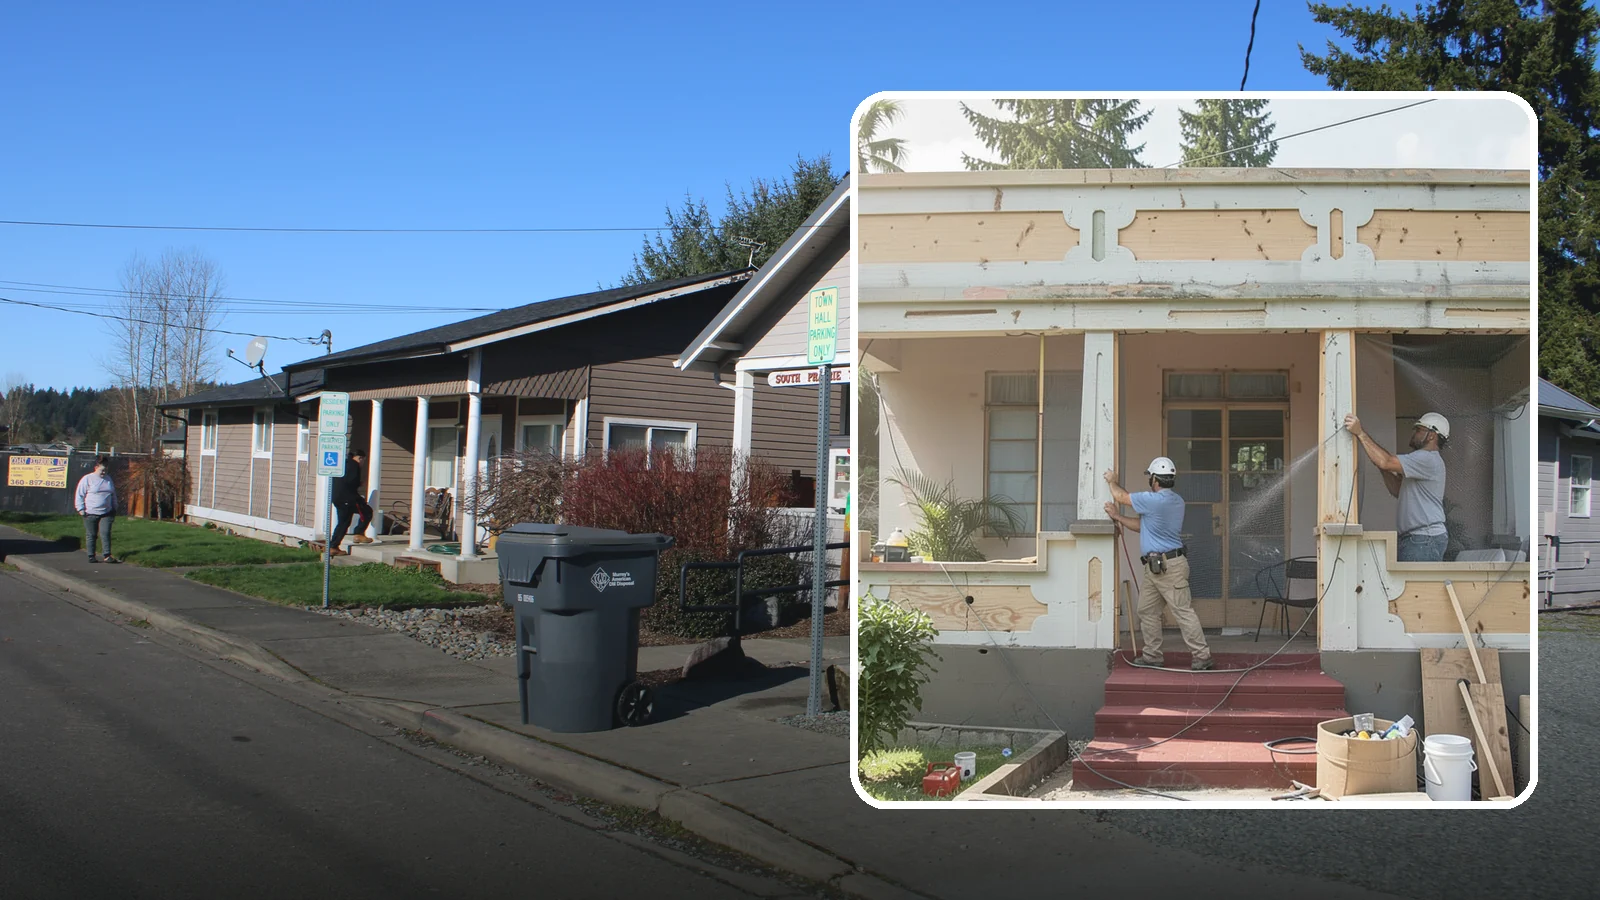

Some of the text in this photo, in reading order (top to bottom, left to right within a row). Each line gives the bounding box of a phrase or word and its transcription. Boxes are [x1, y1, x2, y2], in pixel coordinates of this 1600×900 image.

[815, 294, 833, 308] TOWN
[814, 312, 831, 325] HALL
[810, 326, 836, 341] PARKING
[813, 344, 831, 357] ONLY
[775, 371, 841, 384] SOUTH PRIE
[322, 409, 345, 417] PARKING
